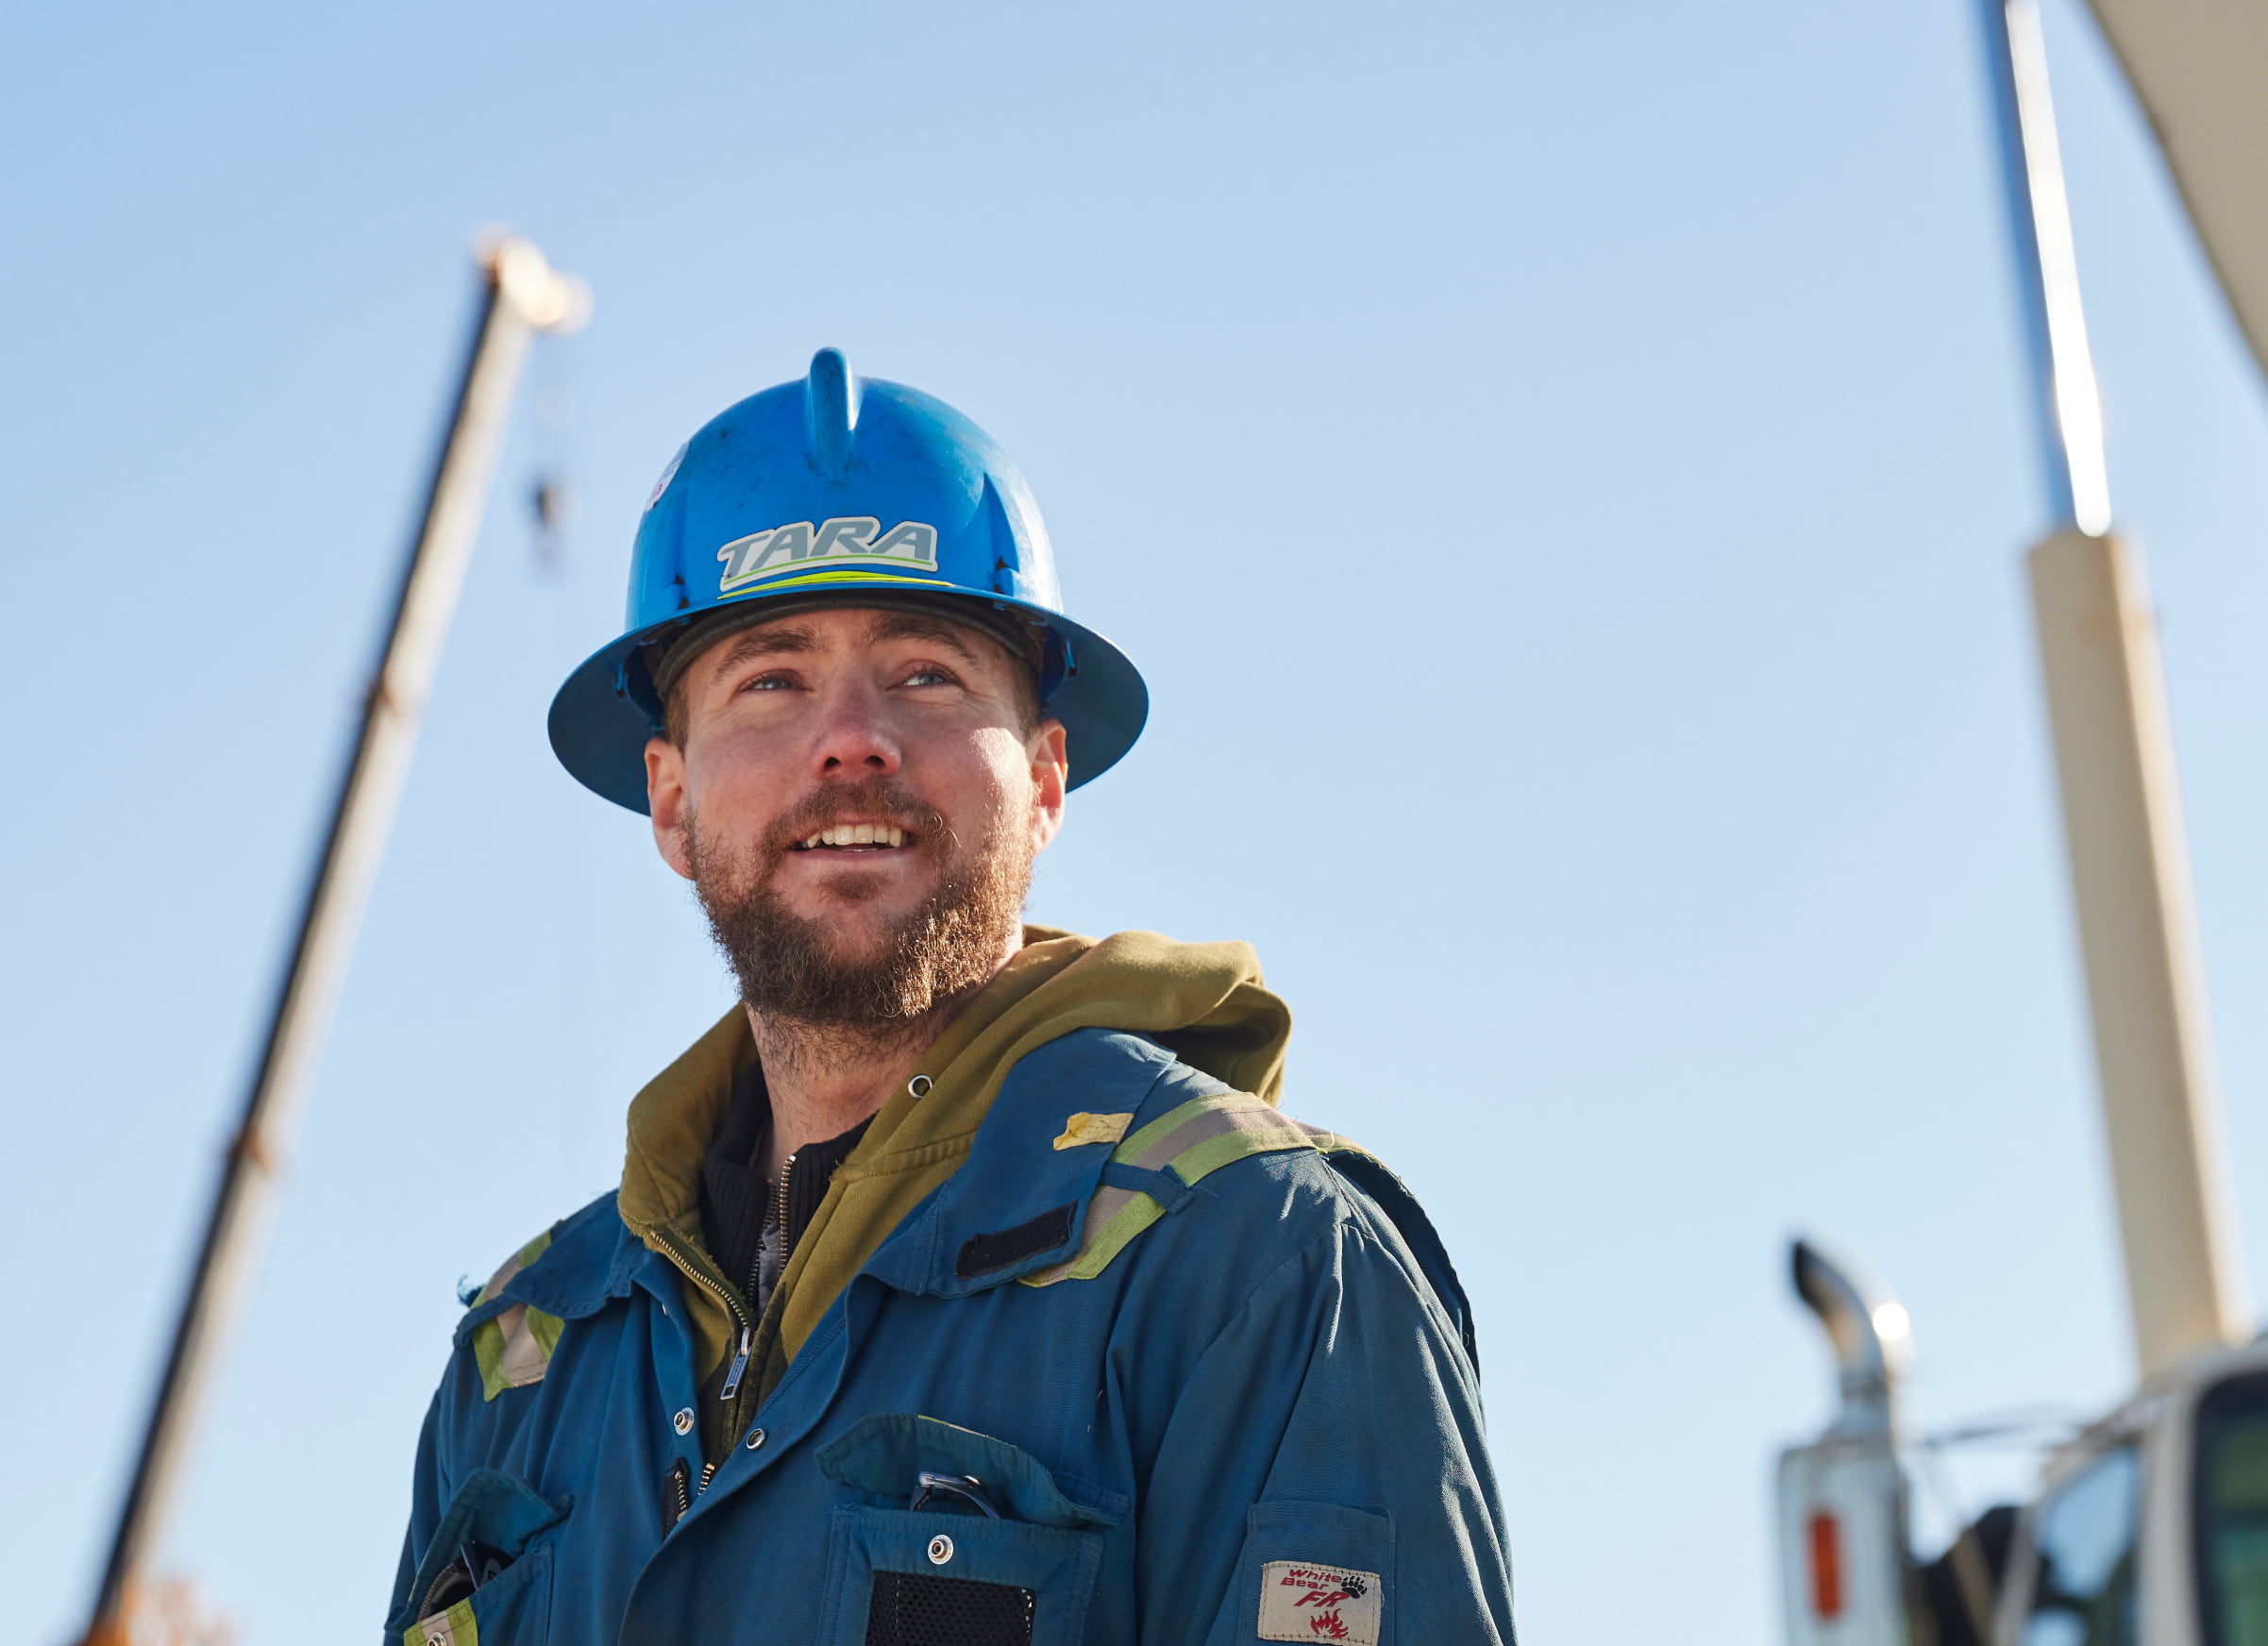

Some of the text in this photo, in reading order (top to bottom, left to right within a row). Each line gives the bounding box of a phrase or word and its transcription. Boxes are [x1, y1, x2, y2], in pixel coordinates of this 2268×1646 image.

[721, 520, 932, 580] TARA
[1280, 1577, 1329, 1590] Bear
[1289, 1569, 1342, 1583] White
[1294, 1590, 1351, 1607] FR
